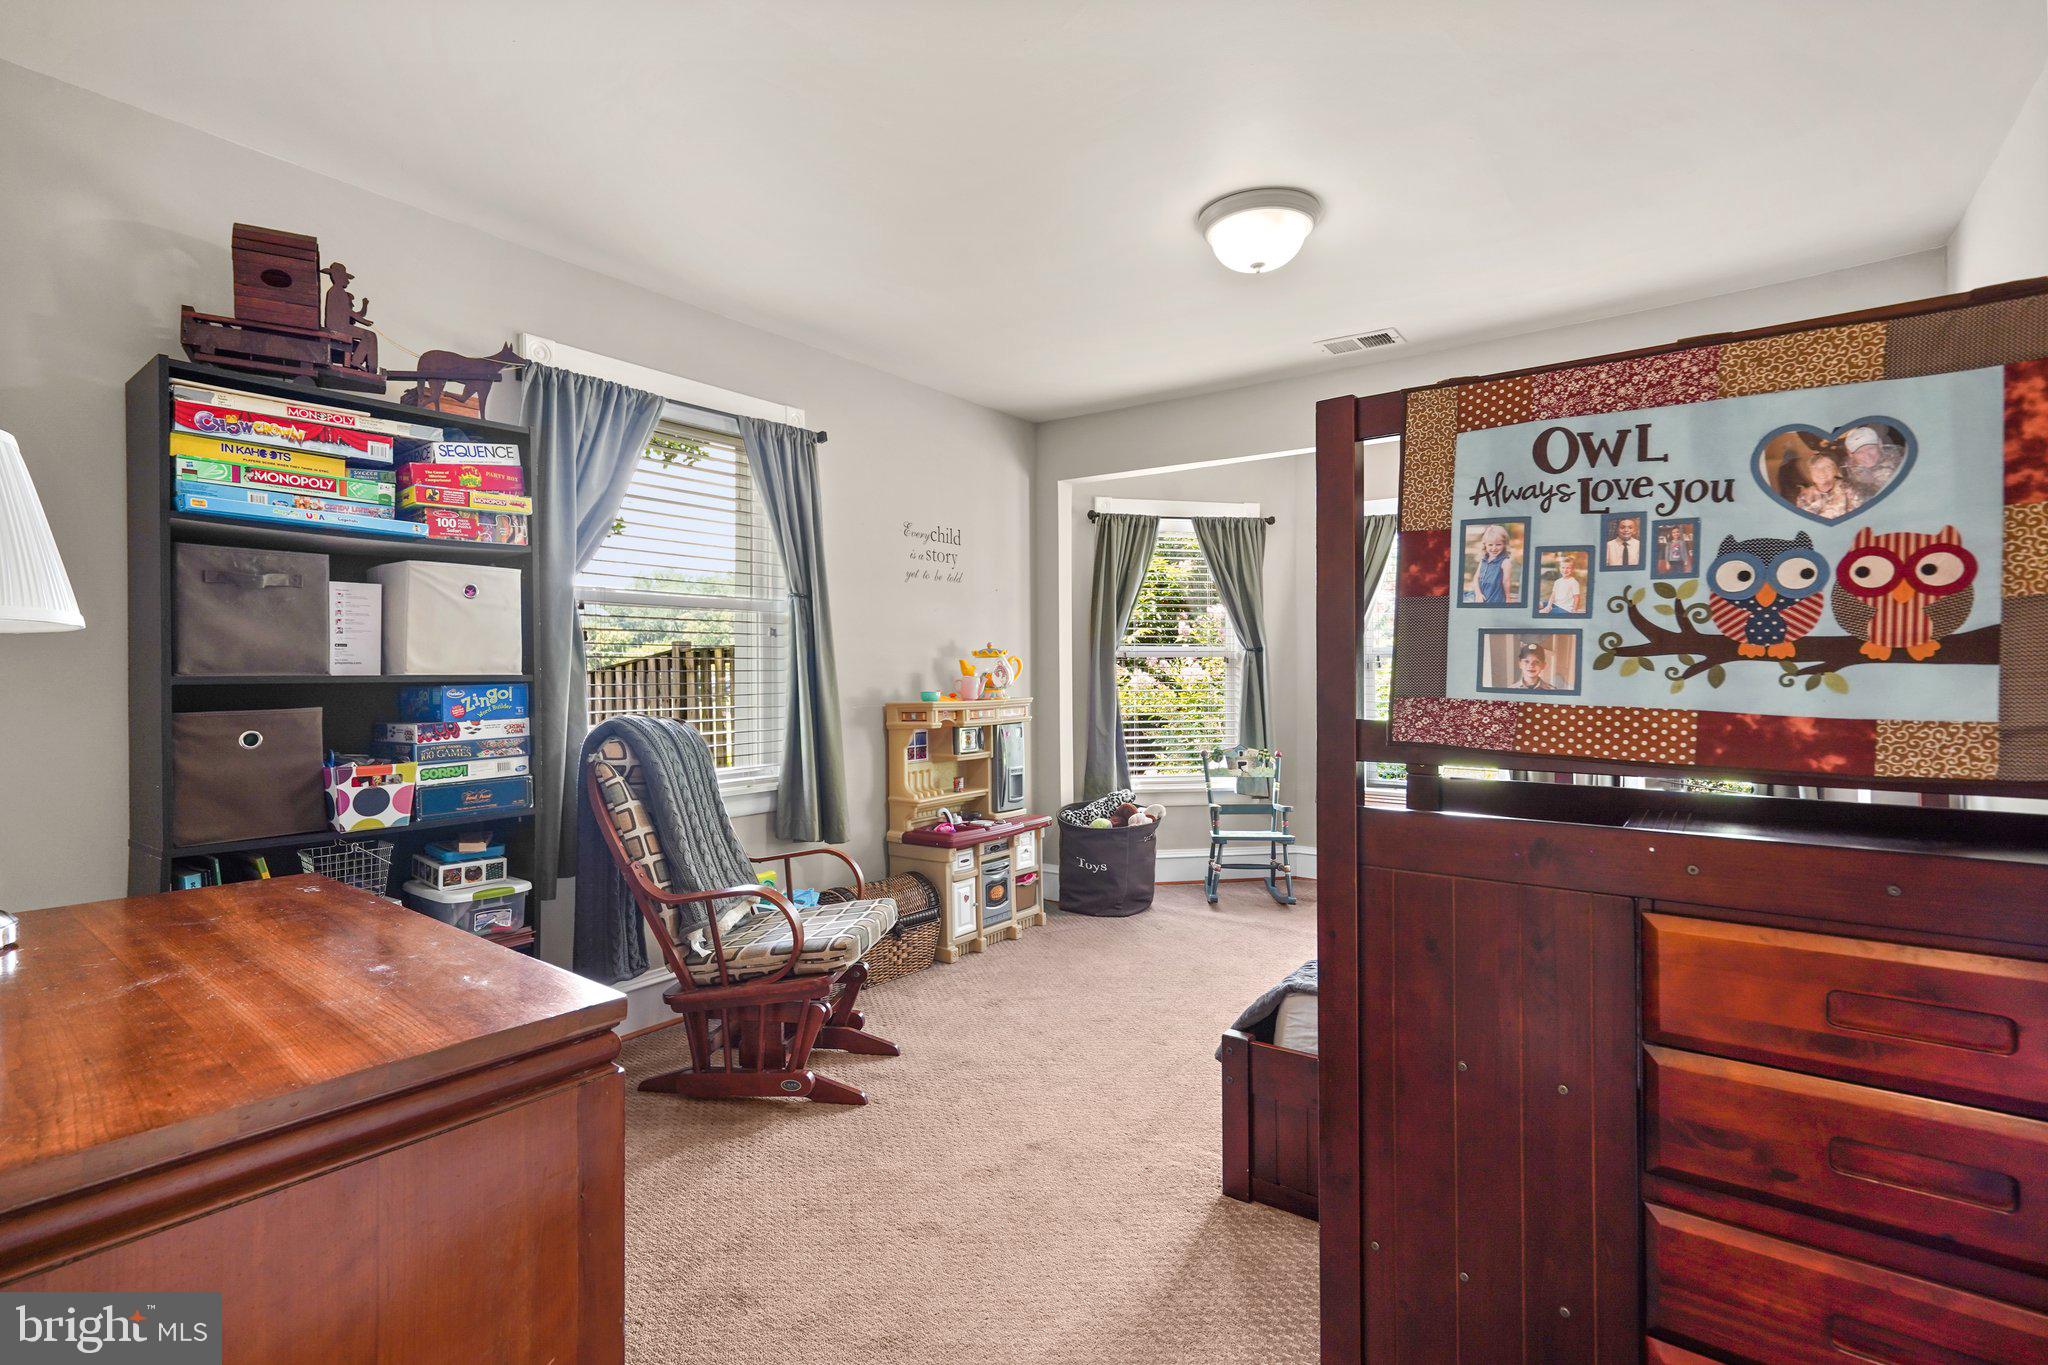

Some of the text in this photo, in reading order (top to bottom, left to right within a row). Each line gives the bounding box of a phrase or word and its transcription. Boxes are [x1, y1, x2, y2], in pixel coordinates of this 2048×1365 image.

[287, 407, 355, 425] MONOPOLY
[220, 442, 234, 454] IN
[438, 444, 514, 459] SEQUENCE
[1532, 423, 1669, 475] OWL
[254, 470, 334, 490] MONOPOLY
[1469, 472, 1576, 513] Always
[1655, 477, 1736, 517] you
[436, 517, 456, 528] 100
[930, 526, 961, 546] child
[925, 549, 958, 570] story
[904, 569, 964, 583] yet to be told
[460, 686, 513, 713] Zingo!
[420, 764, 469, 780] SORRY!
[1076, 856, 1108, 874] Toys
